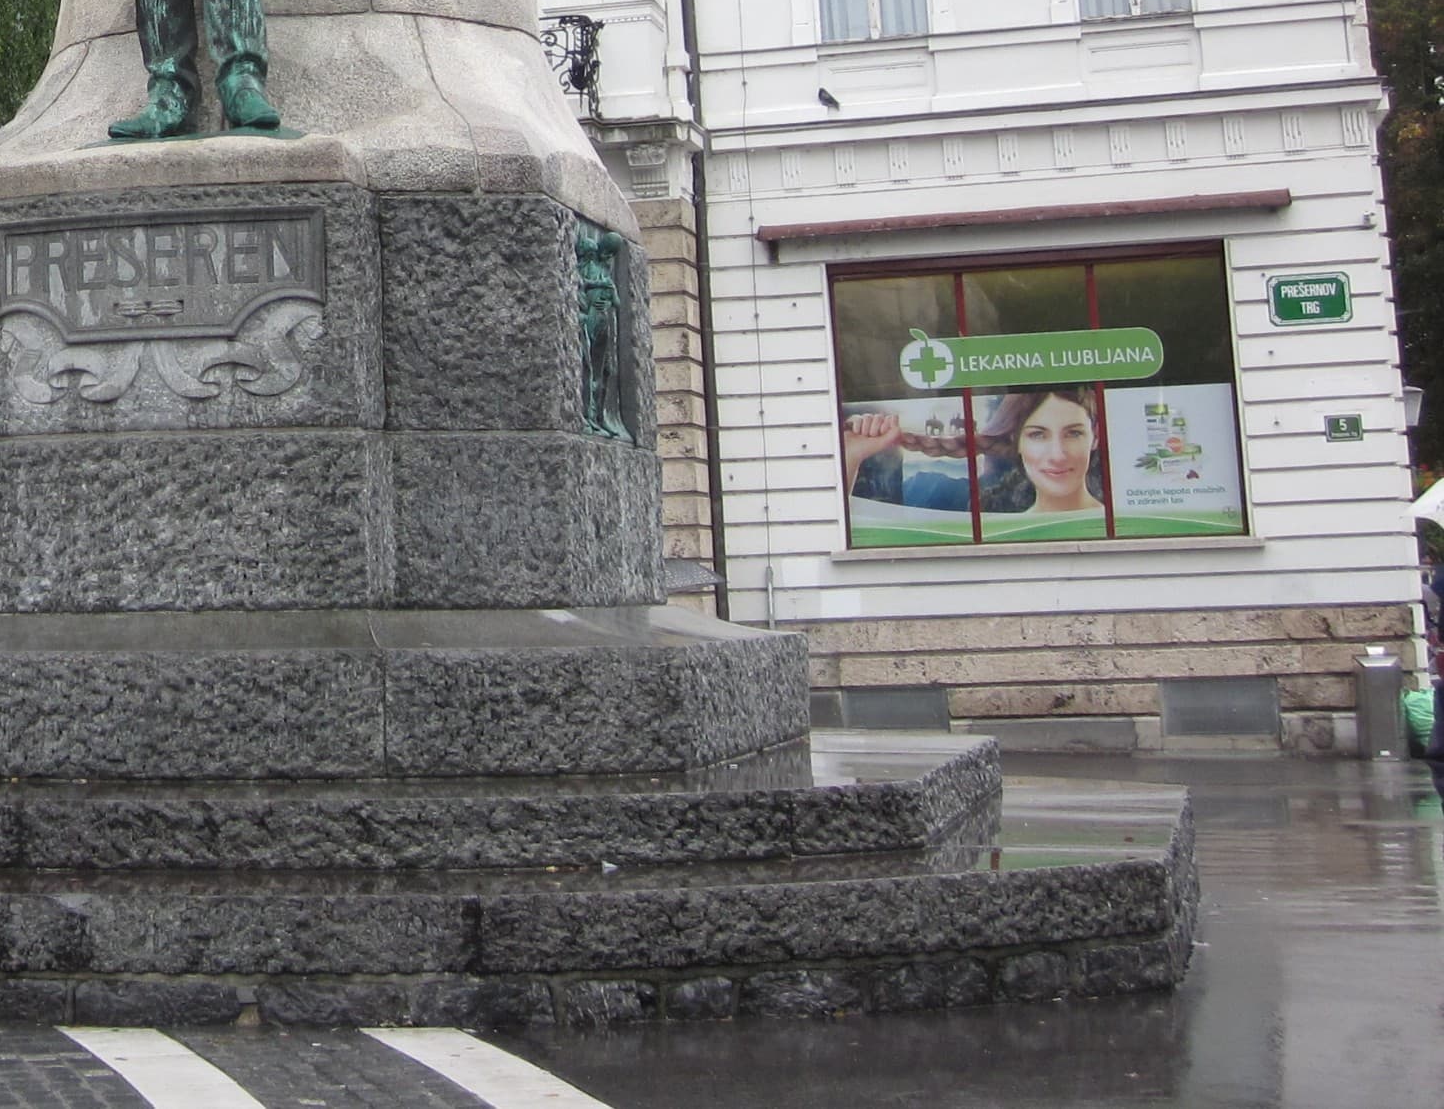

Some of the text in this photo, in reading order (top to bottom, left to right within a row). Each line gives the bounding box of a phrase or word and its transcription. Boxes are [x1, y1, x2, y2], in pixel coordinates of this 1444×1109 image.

[1280, 282, 1336, 298] PREŠERNOV
[1300, 301, 1320, 315] TRG
[960, 346, 1155, 372] LEKARNA LJUBLJANA
[1339, 418, 1347, 431] 5
